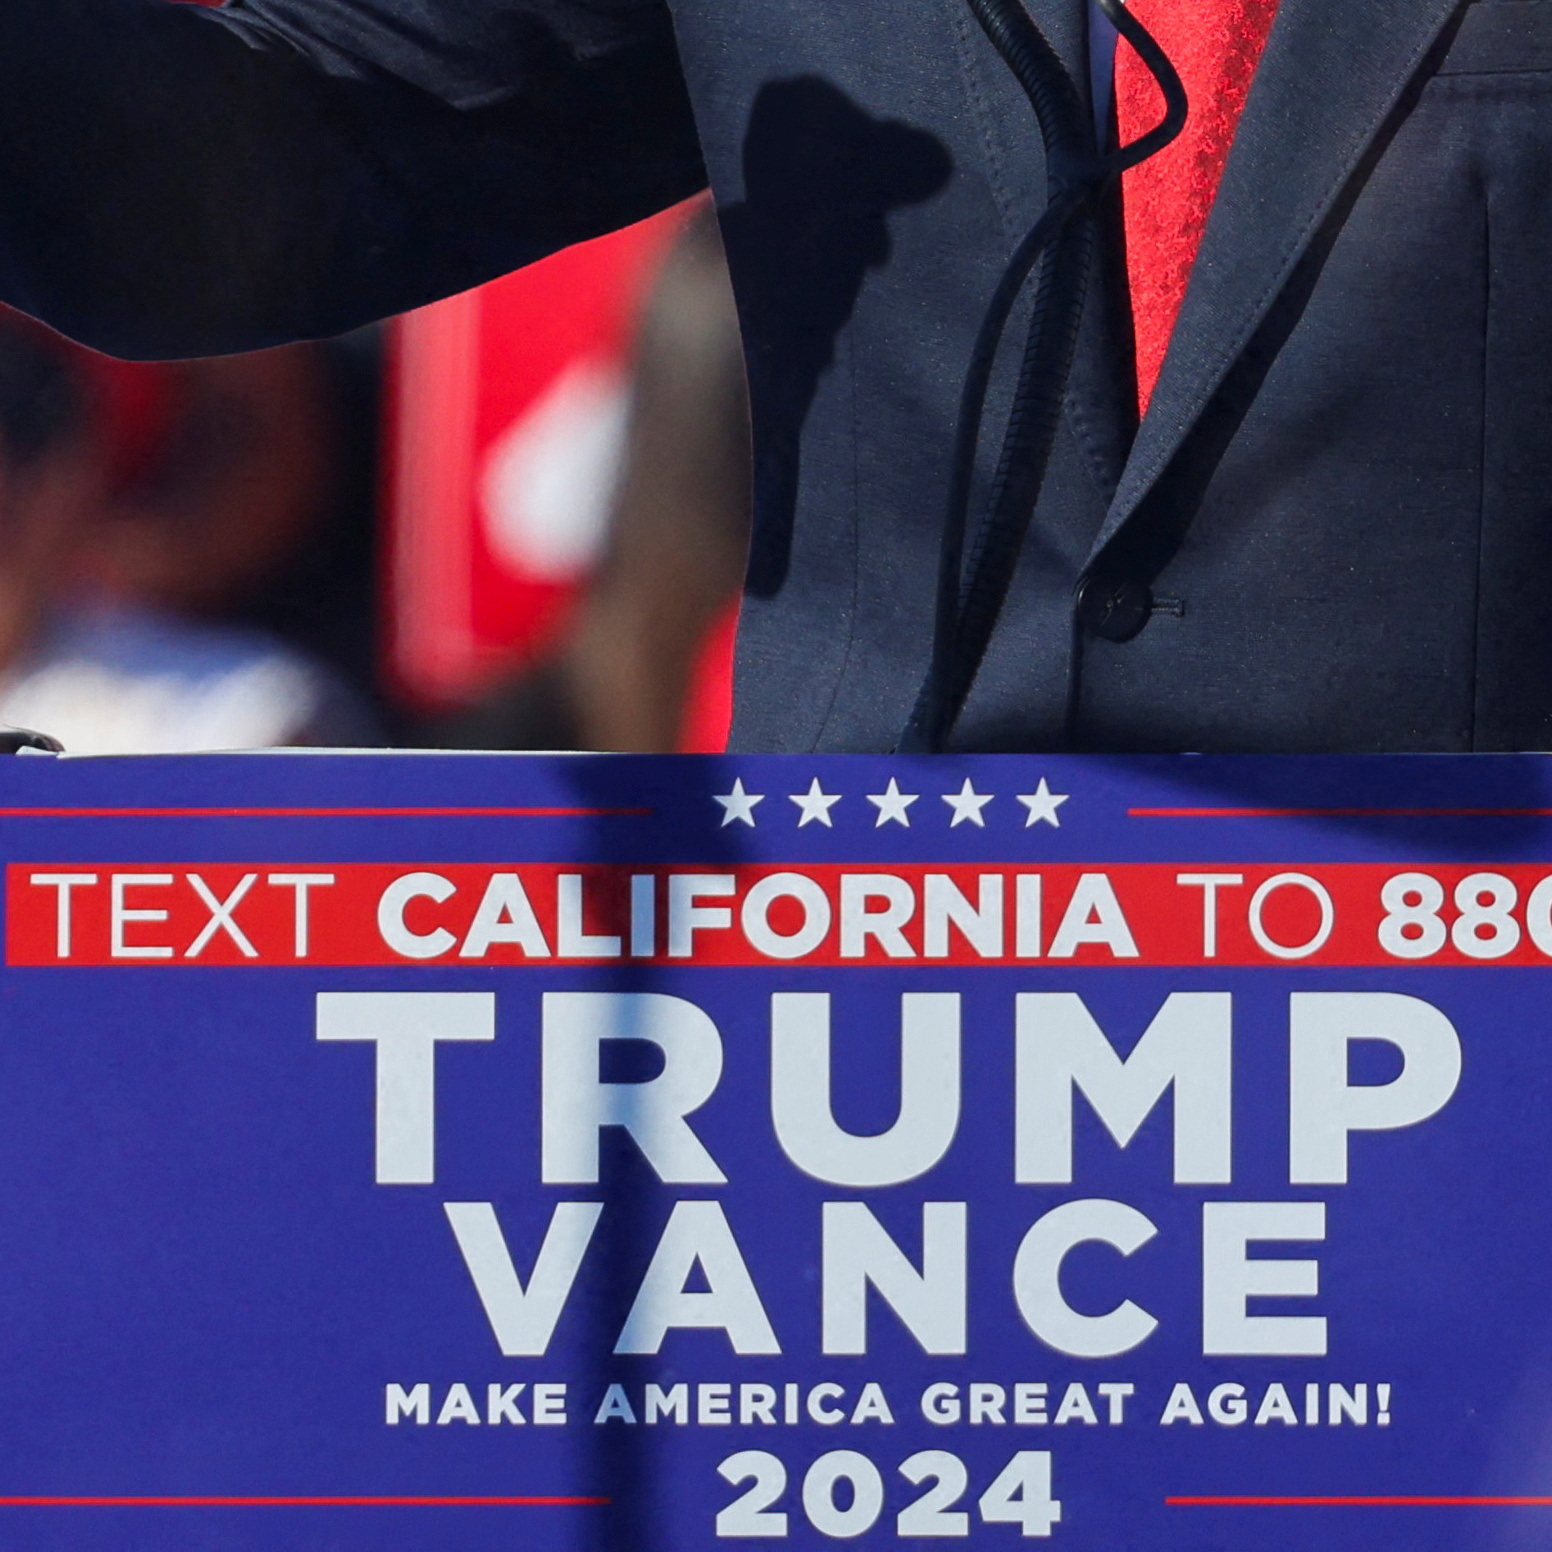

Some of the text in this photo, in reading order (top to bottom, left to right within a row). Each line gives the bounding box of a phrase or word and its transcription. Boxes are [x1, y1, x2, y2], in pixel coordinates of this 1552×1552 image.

[31, 874, 334, 957] TEXT
[378, 872, 1139, 959] CALIFORNIA
[1177, 873, 1333, 959] TO
[316, 992, 1464, 1187] TRUMP
[444, 1199, 1327, 1357] VANCE
[386, 1383, 1390, 1425] MAKE AMERICA GREAT AGAIN!
[717, 1450, 1060, 1537] 2024
